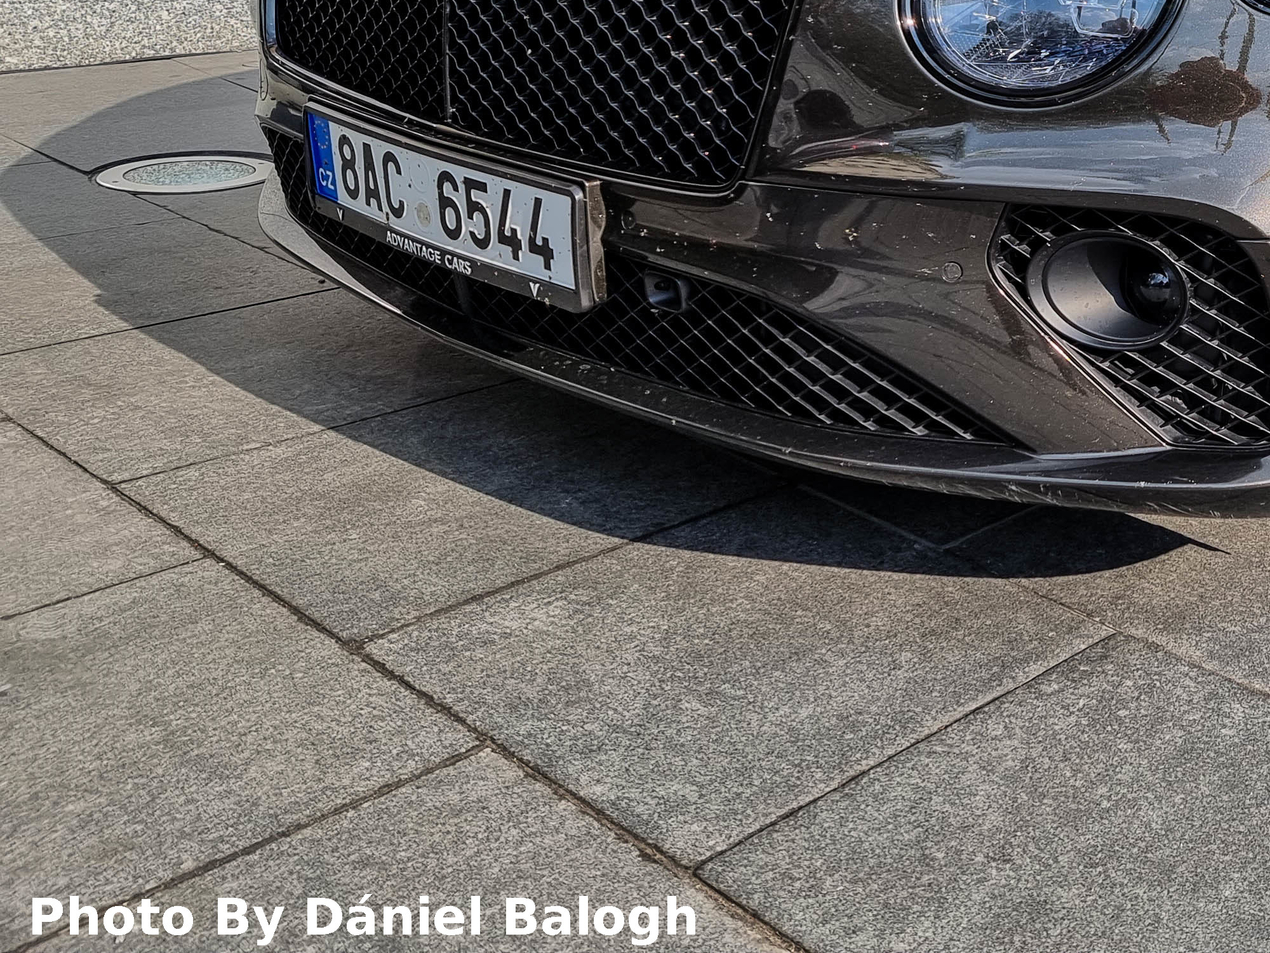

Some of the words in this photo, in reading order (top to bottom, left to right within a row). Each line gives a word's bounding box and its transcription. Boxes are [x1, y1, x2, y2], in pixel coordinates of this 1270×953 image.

[318, 167, 335, 190] CZ
[337, 133, 406, 220] 8AC
[436, 169, 555, 273] 6544
[386, 230, 442, 264] ADVANTAGE
[444, 254, 472, 276] CARS
